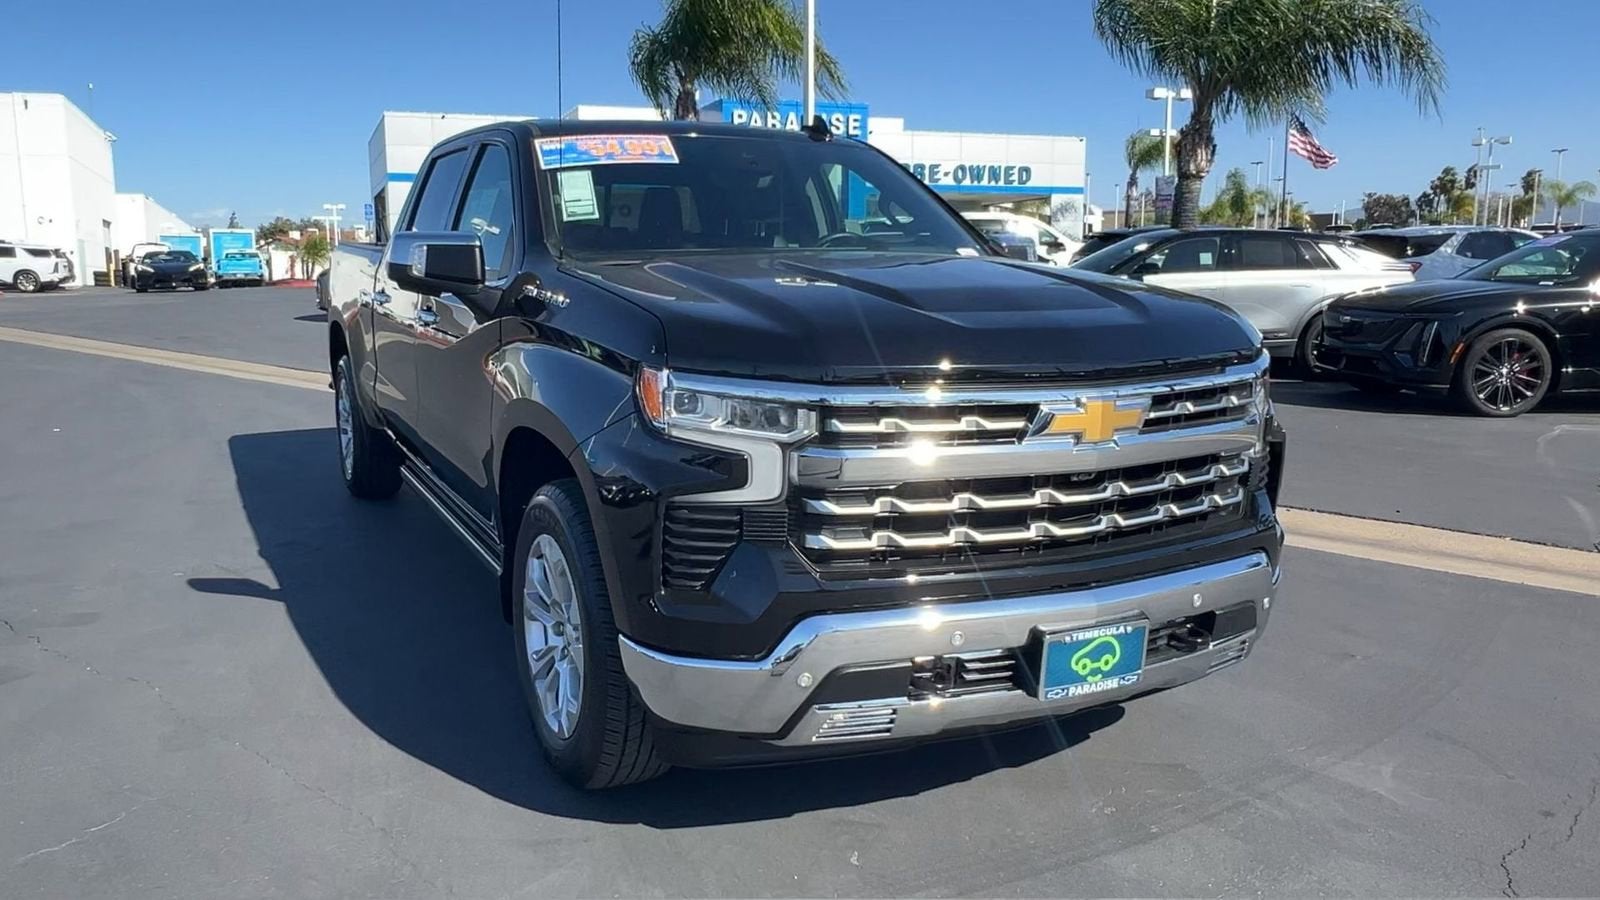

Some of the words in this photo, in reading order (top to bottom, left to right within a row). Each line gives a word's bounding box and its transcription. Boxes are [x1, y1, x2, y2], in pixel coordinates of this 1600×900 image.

[732, 109, 862, 136] PARASE
[1071, 625, 1125, 641] TEMECULA
[1068, 678, 1119, 697] PARADISE
